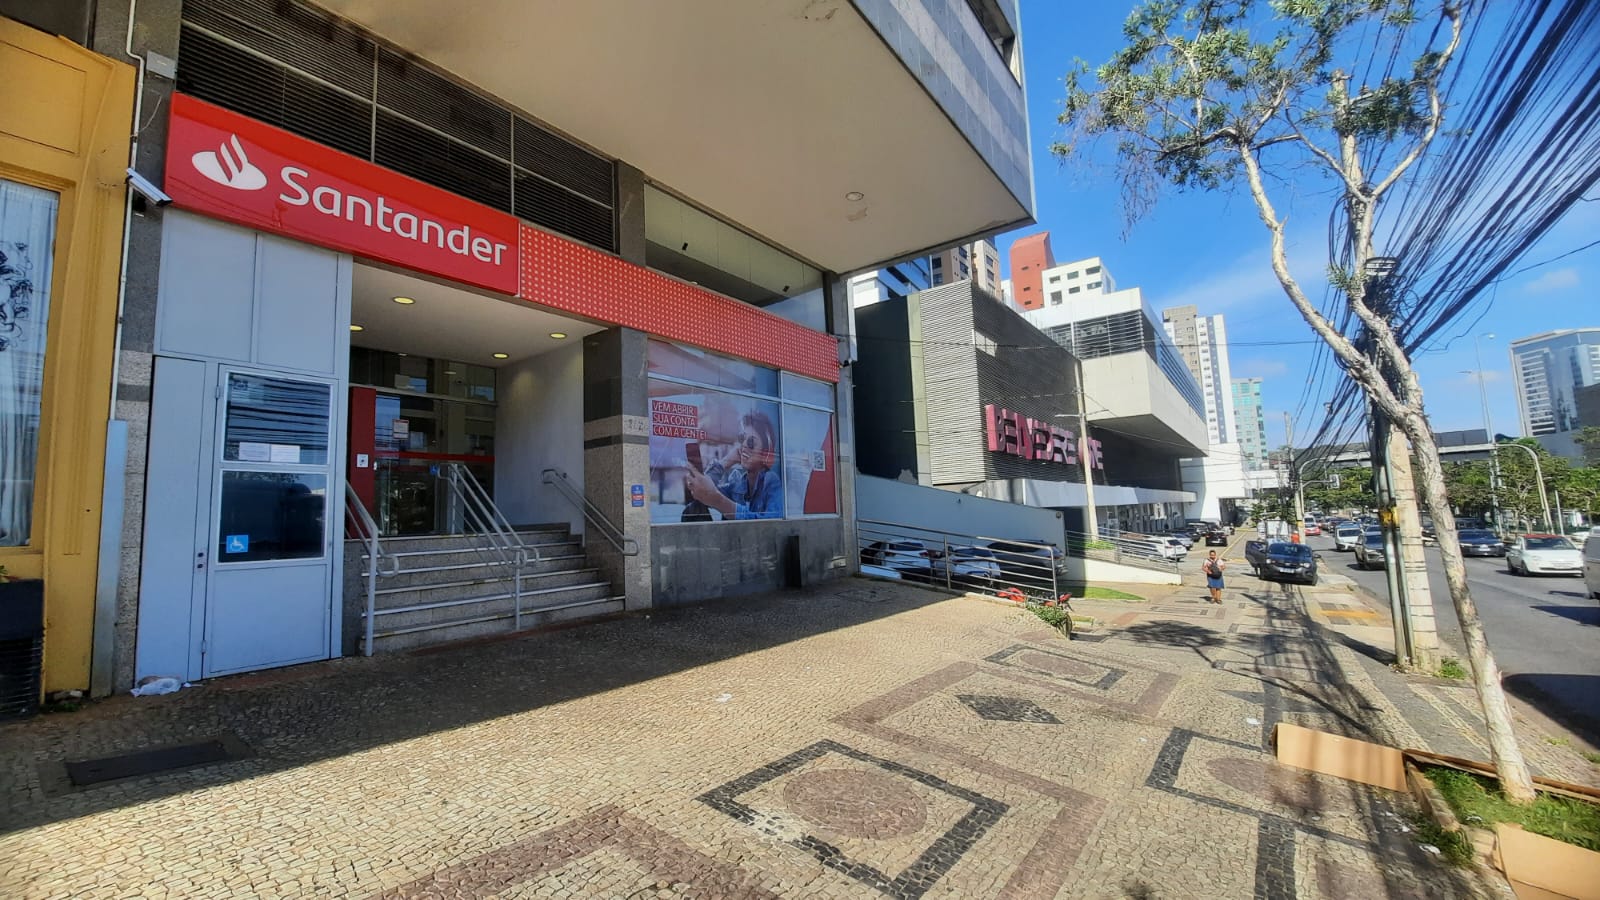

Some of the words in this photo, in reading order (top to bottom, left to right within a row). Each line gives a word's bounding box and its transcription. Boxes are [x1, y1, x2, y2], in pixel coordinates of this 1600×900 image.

[279, 166, 507, 266] Santander
[653, 402, 671, 412] VEM
[672, 405, 694, 415] ABRIR
[653, 413, 669, 424] SUA
[670, 416, 695, 426] CONTA
[654, 426, 672, 436] COM
[673, 428, 679, 437] A
